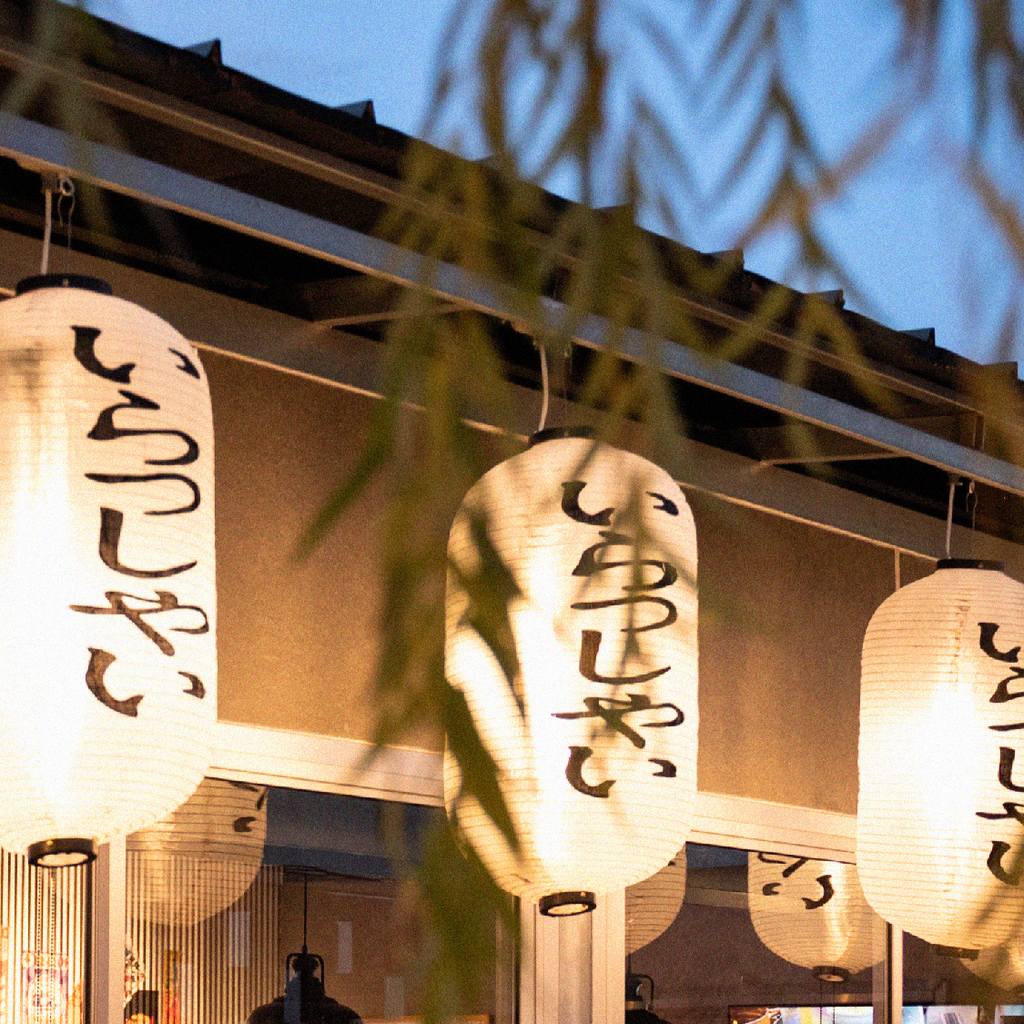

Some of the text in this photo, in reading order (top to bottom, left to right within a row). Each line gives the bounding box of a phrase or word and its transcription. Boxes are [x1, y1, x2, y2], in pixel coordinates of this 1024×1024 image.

[69, 325, 210, 717] いらっしゃい
